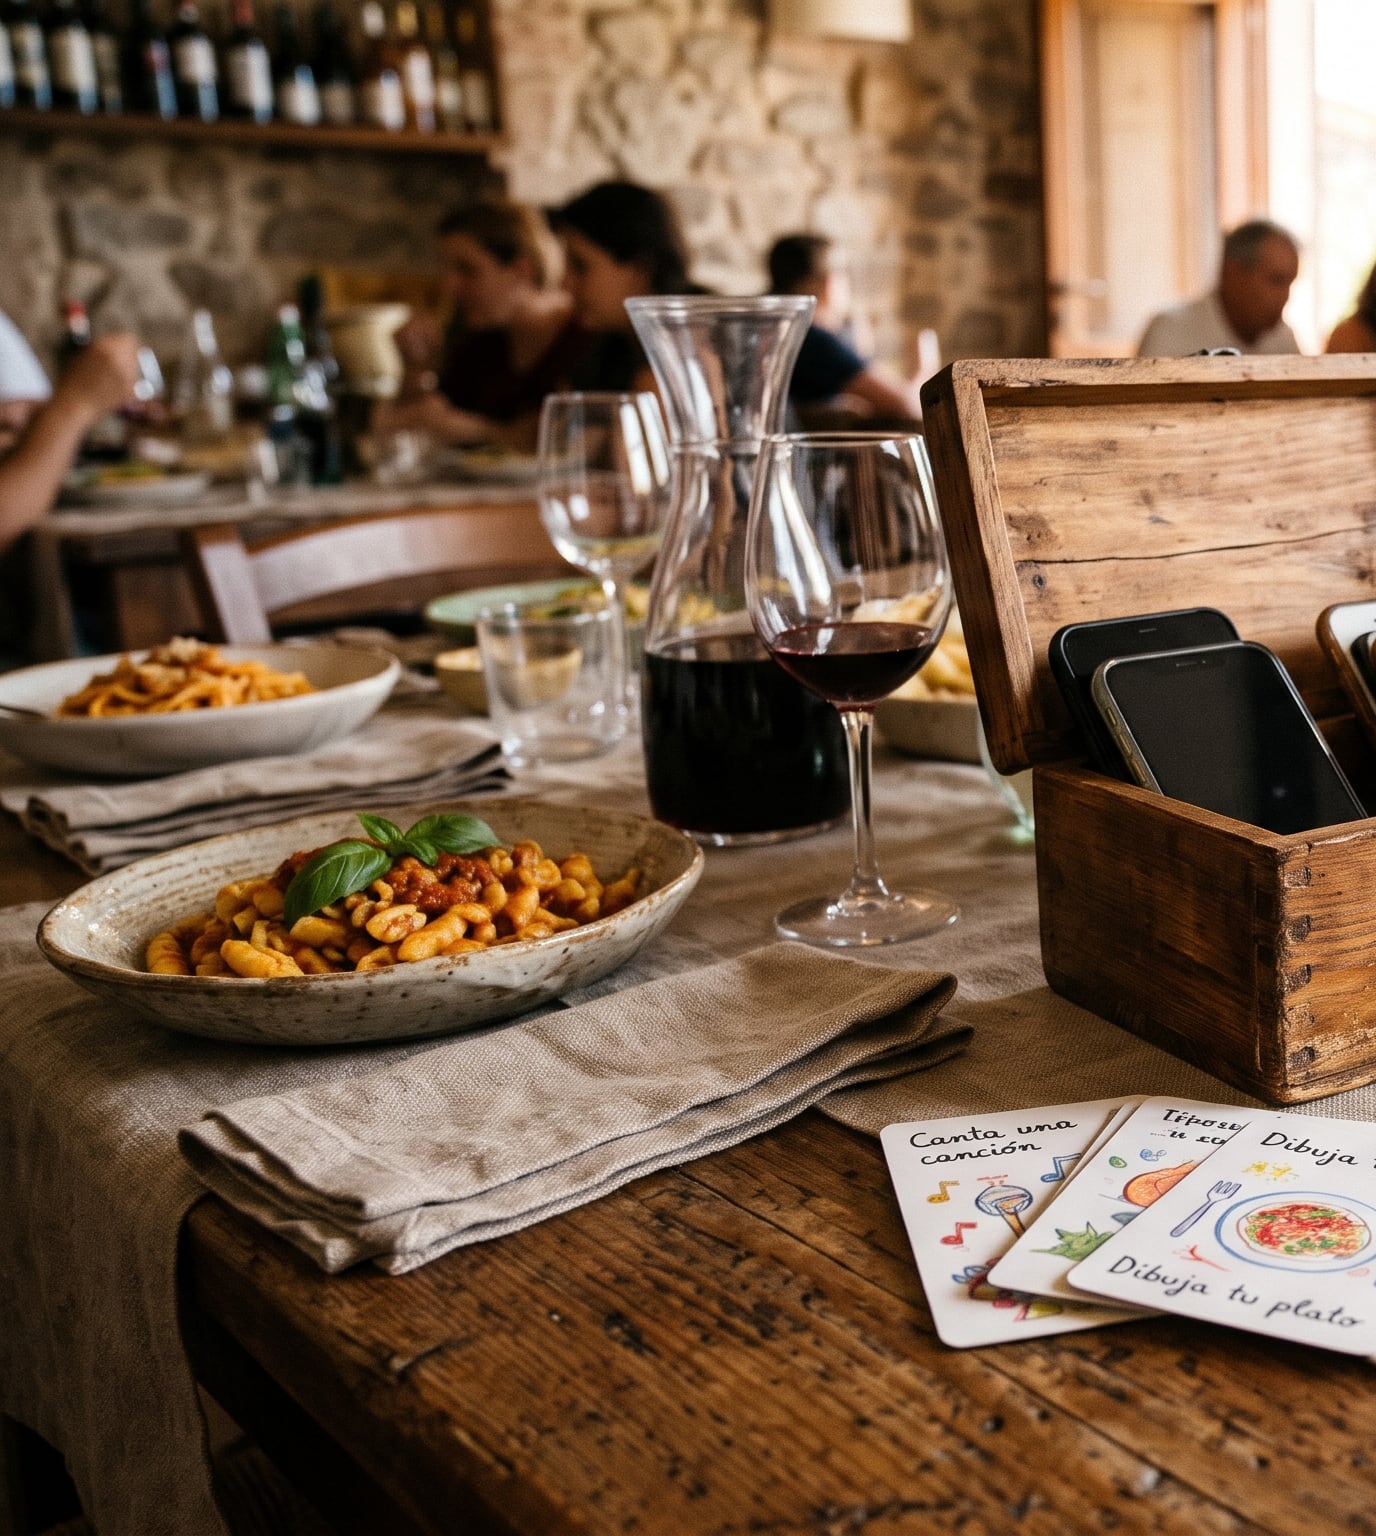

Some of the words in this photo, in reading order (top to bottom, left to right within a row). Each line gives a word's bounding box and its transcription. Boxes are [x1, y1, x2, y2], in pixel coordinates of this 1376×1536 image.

[909, 1126, 1006, 1148] Canta
[1017, 1120, 1078, 1135] una
[1260, 1131, 1358, 1166] Dibuja
[920, 1141, 1042, 1165] canción
[1107, 1255, 1210, 1296] Dibuja
[1228, 1283, 1260, 1304] tu
[1264, 1299, 1365, 1328] plato
